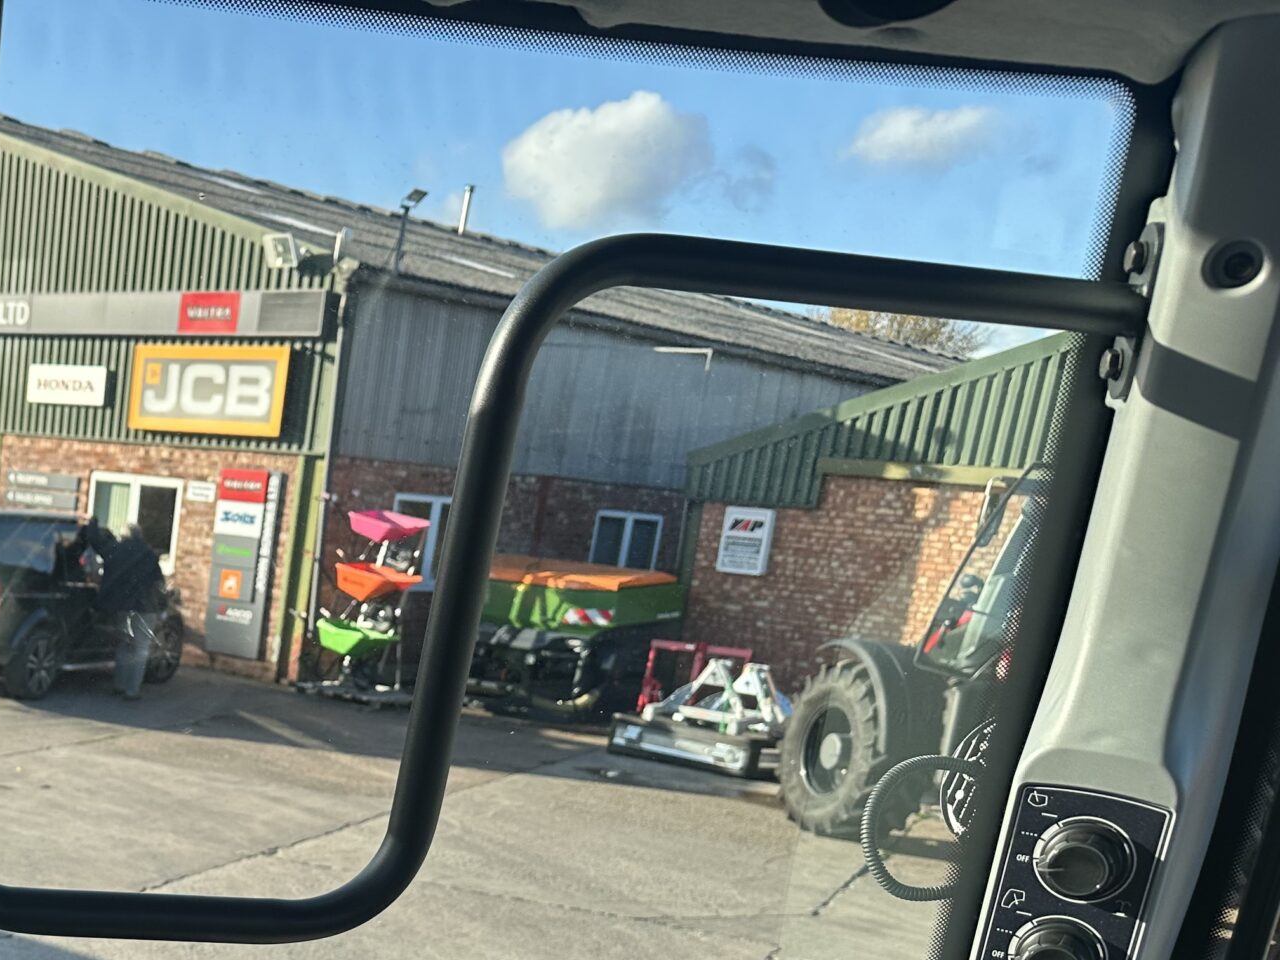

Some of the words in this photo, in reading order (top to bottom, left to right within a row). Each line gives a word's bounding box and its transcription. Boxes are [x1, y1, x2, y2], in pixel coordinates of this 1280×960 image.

[36, 378, 95, 393] HONDA
[143, 362, 271, 417] JCB
[1016, 854, 1030, 863] OFF
[991, 950, 1005, 959] OFF
